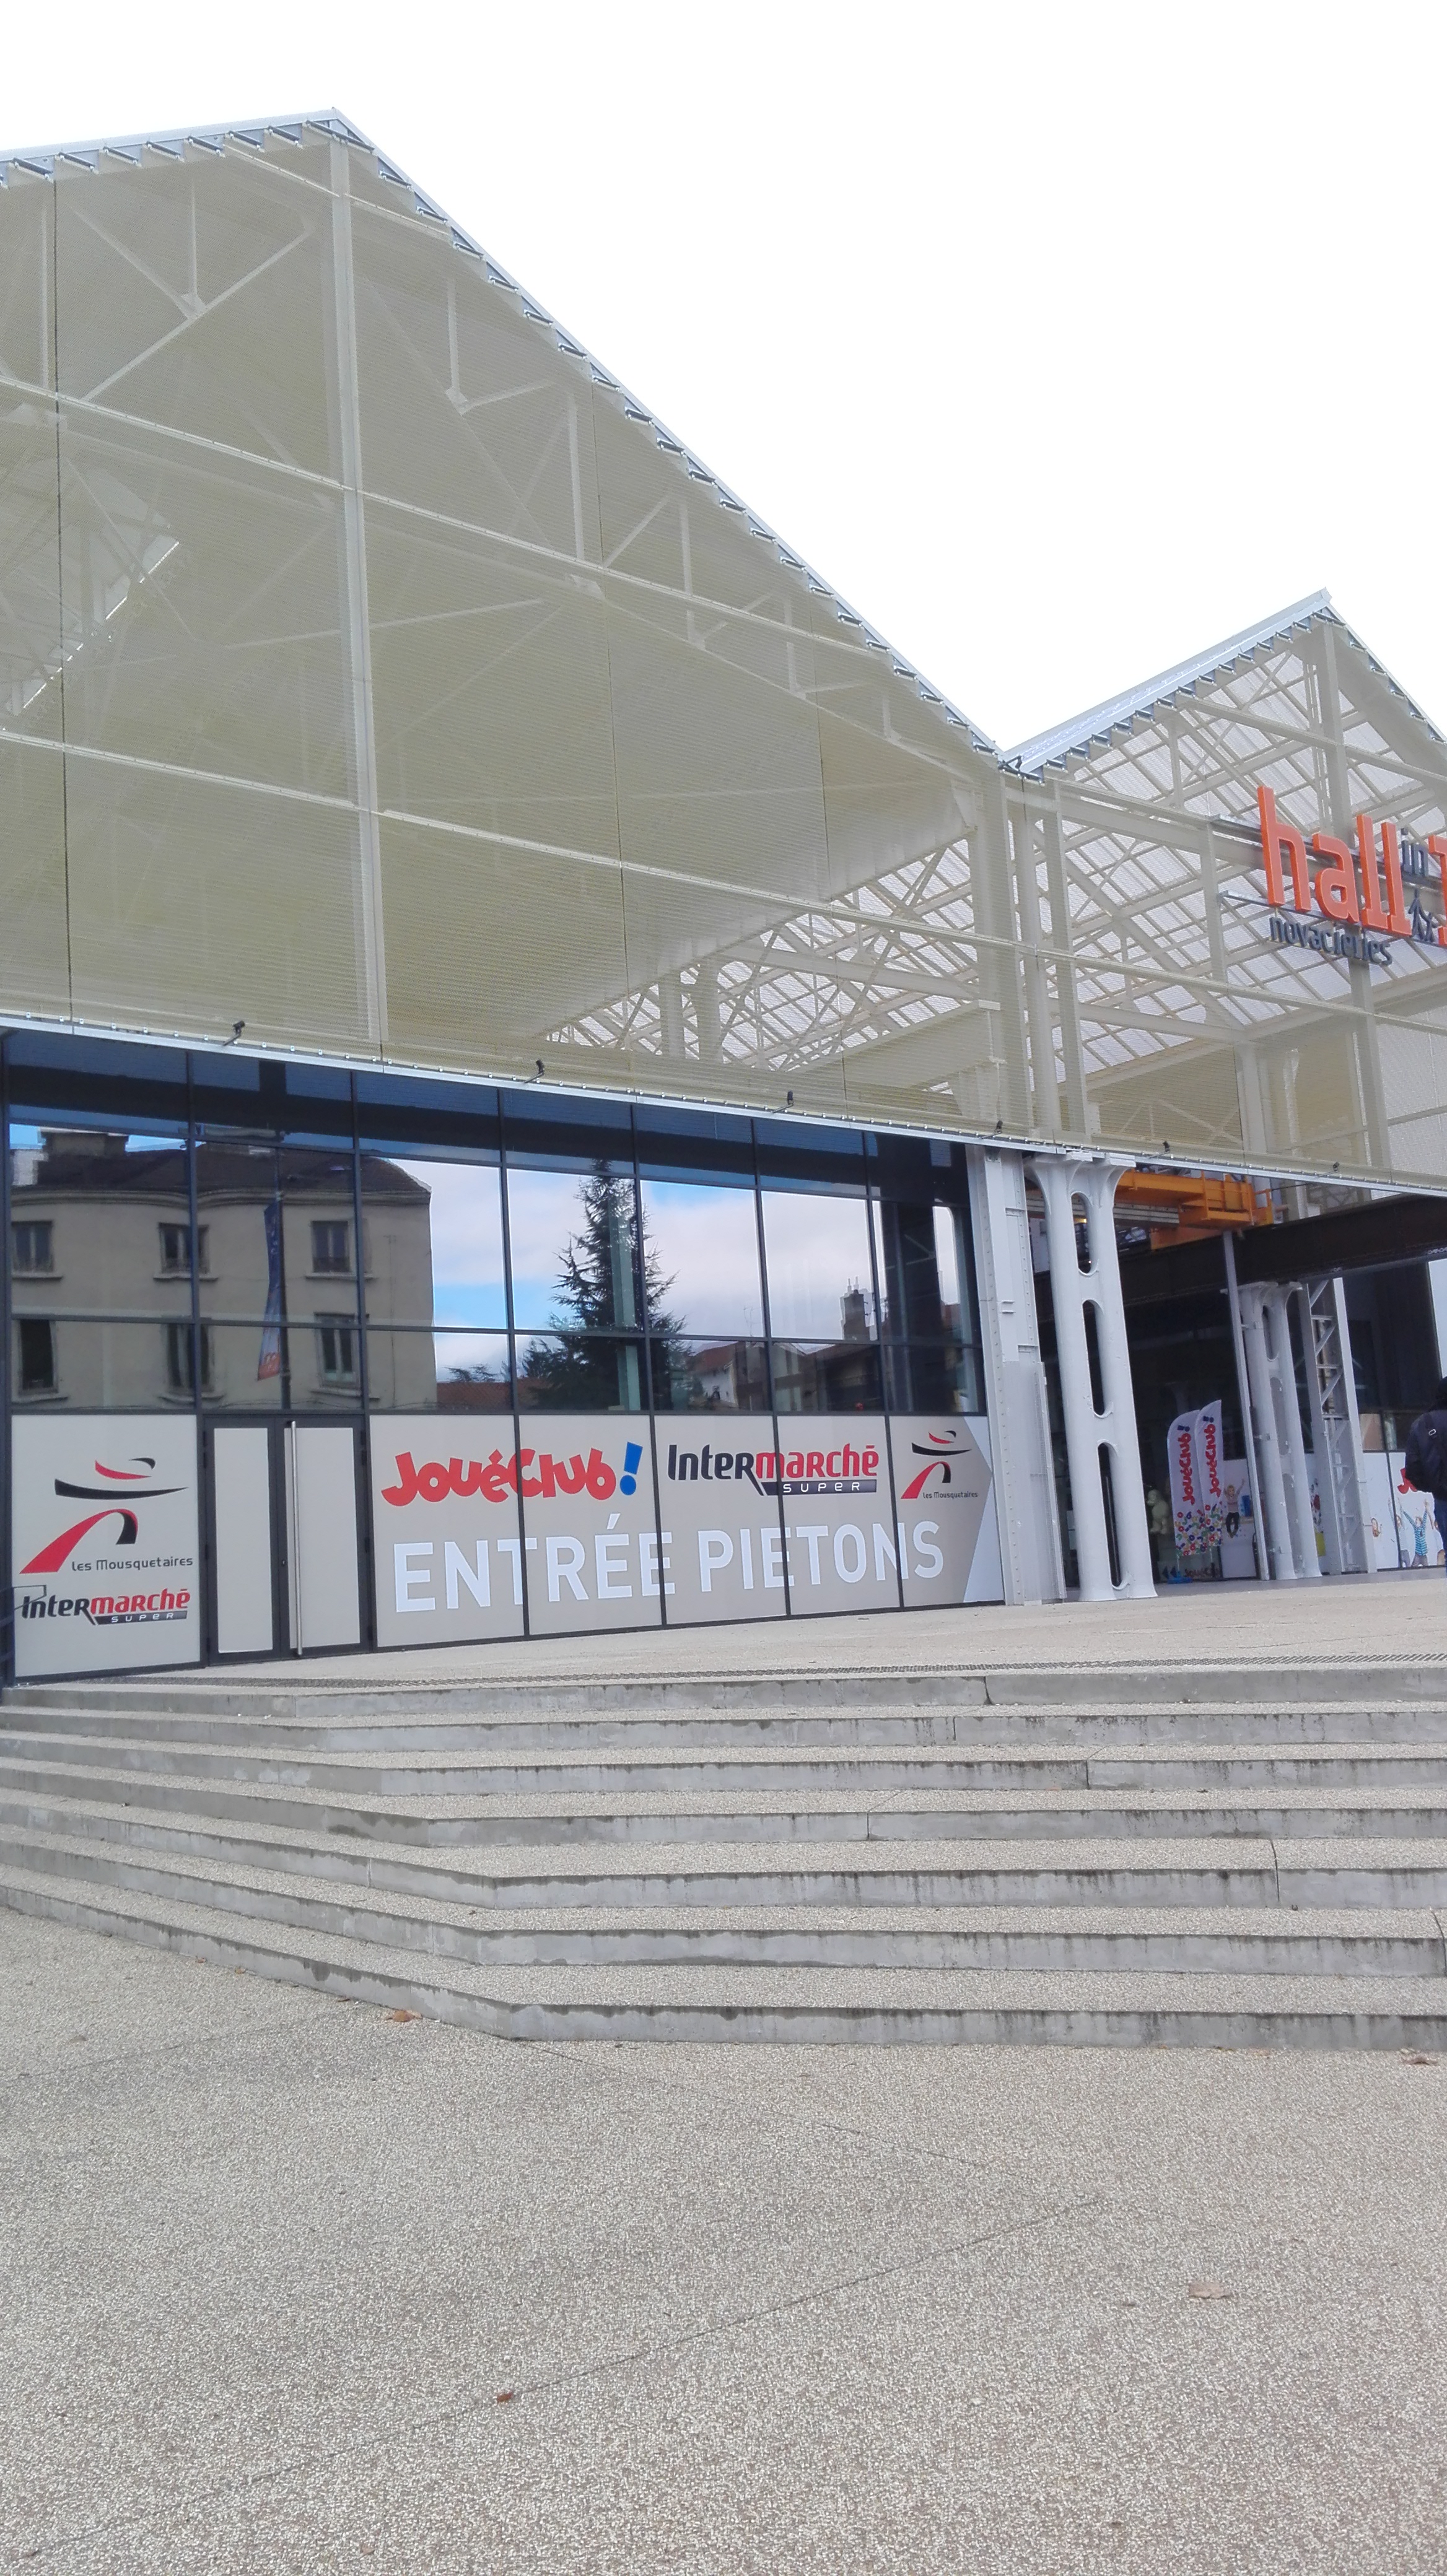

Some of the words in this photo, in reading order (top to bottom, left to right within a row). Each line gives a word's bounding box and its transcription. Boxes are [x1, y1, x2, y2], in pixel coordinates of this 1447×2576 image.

[1257, 786, 1412, 936] hall
[1401, 827, 1429, 877] in
[933, 1490, 978, 1499] Mousquetaires
[72, 1561, 92, 1572] les
[96, 1556, 193, 1571] Mousquetaires
[394, 1513, 676, 1612] ENTRÉE
[697, 1521, 943, 1592] PIETONS
